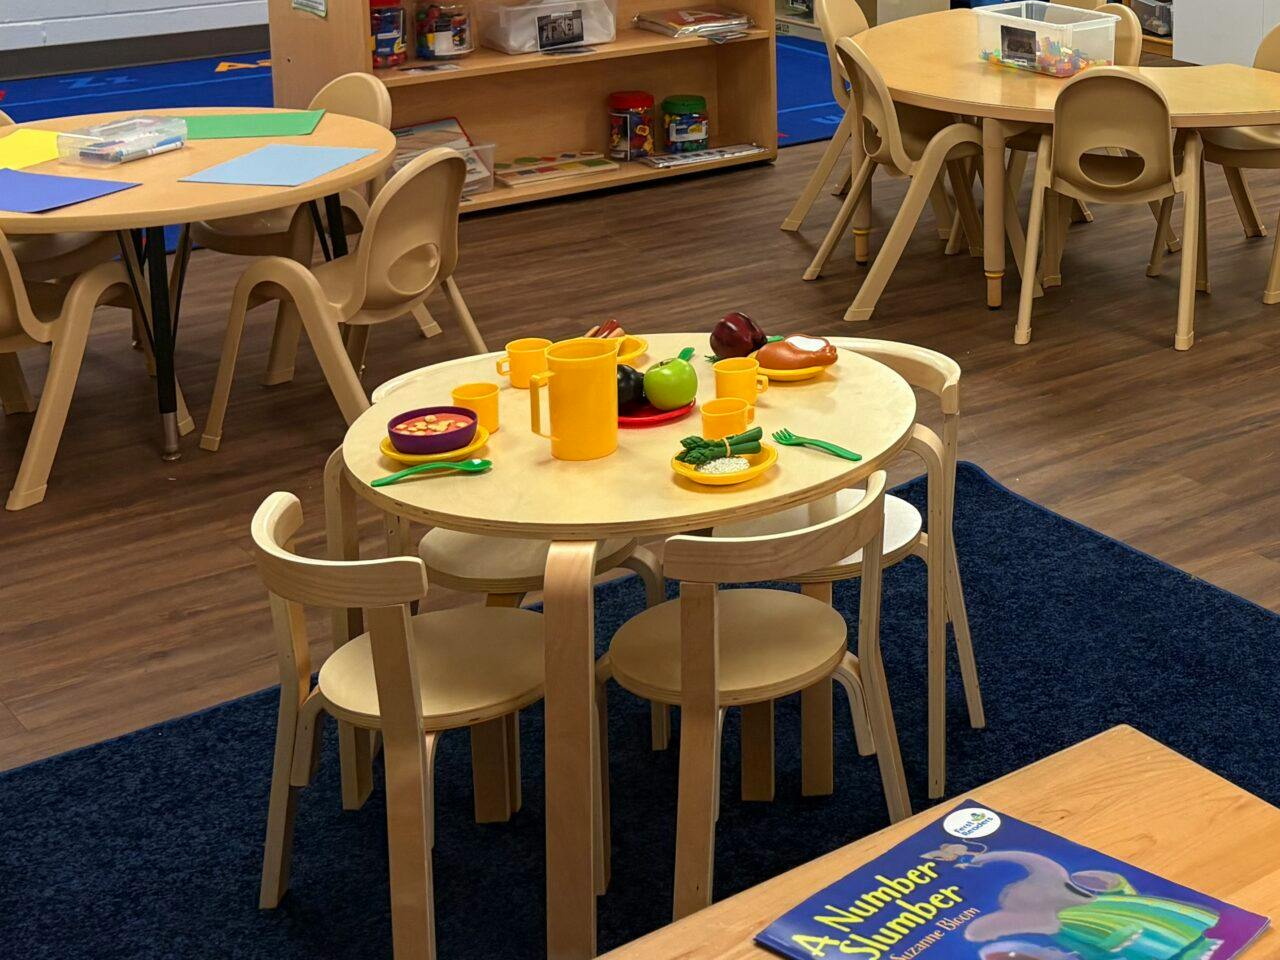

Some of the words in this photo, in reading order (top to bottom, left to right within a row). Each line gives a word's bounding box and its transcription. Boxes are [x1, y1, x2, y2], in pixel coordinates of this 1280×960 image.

[962, 817, 993, 836] Readers
[814, 861, 938, 932] Number
[839, 885, 963, 960] Slumber
[936, 906, 981, 932] Bloom
[791, 934, 841, 957] A
